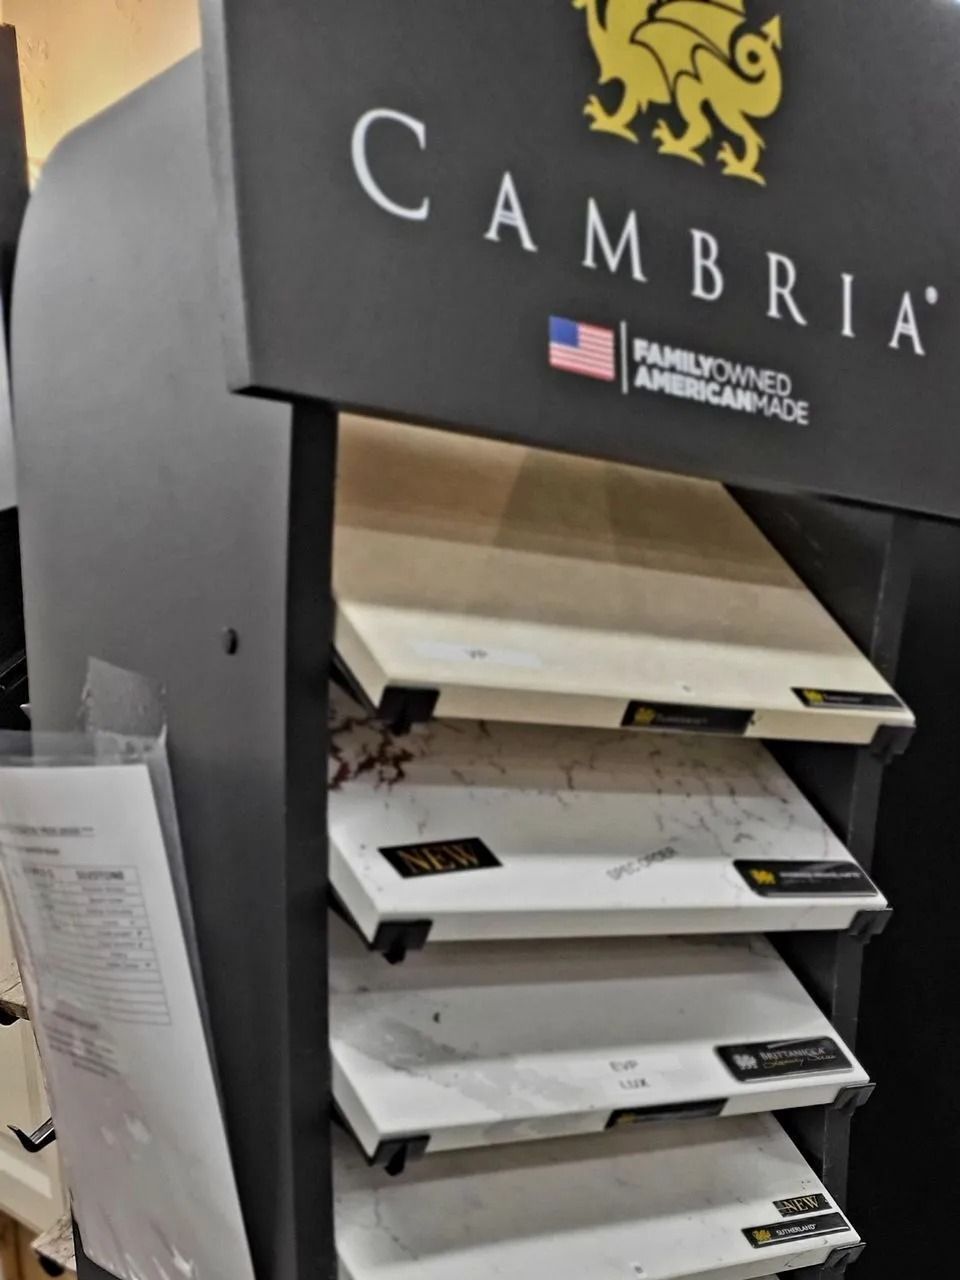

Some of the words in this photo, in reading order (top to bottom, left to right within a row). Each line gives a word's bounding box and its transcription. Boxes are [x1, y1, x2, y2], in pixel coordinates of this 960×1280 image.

[397, 846, 481, 875] NEW
[784, 1195, 819, 1213] NEW
[776, 1223, 816, 1236] SUTHERLAND
